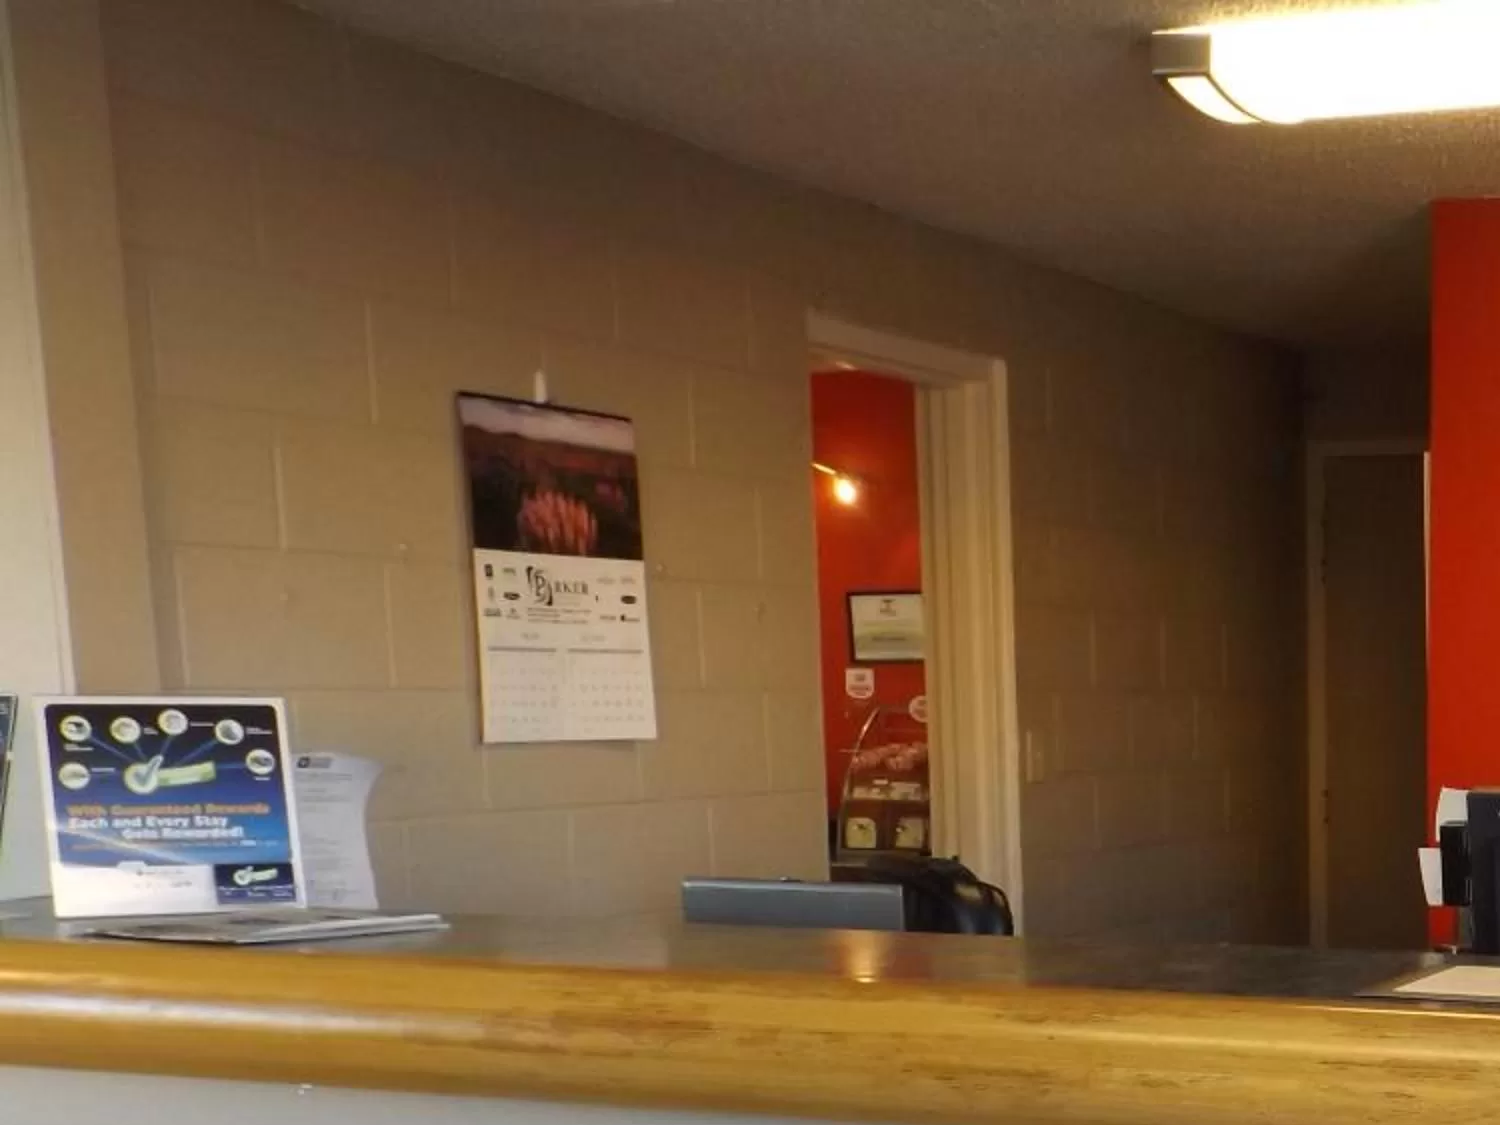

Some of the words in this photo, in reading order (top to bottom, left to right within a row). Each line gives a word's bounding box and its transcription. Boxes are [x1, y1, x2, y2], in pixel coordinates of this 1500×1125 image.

[68, 816, 108, 829] Each
[112, 816, 142, 828] and
[146, 815, 190, 830] Every
[193, 815, 228, 829] Stay
